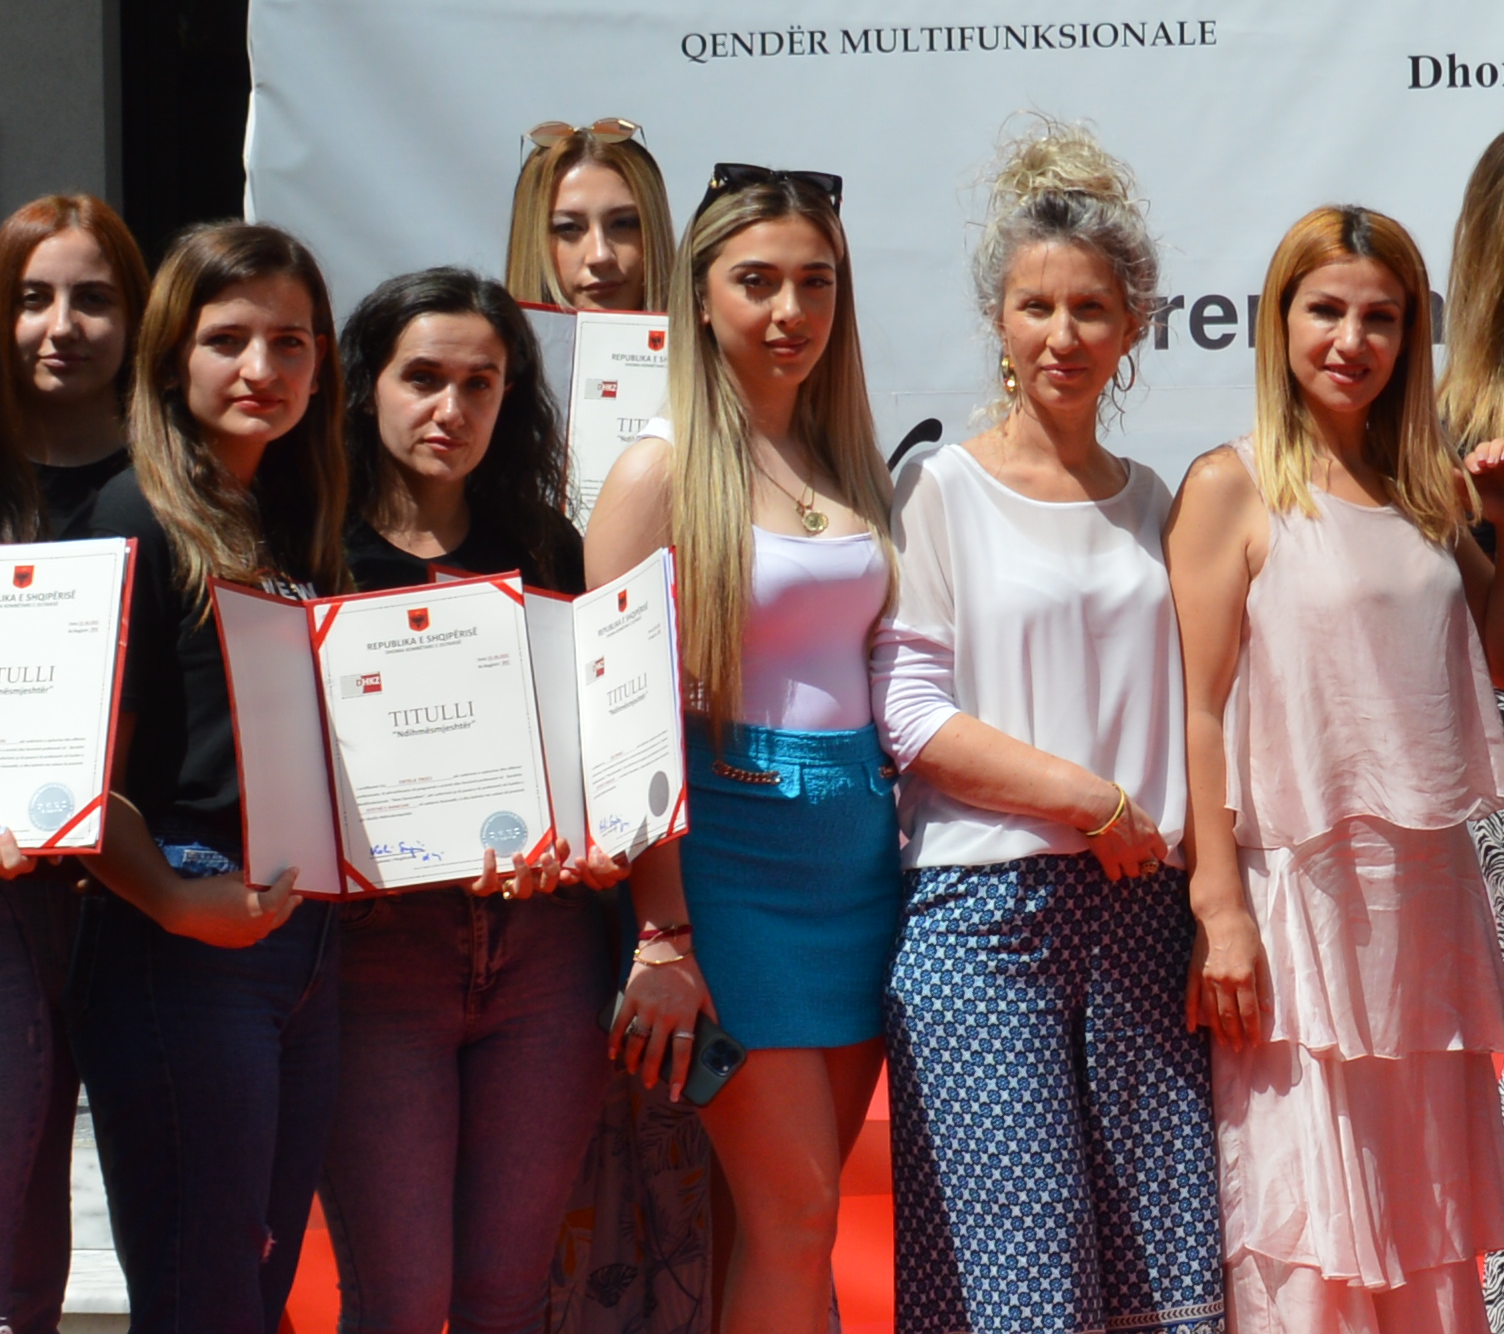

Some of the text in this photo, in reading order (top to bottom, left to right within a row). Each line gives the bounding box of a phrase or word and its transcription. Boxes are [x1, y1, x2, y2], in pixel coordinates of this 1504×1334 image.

[680, 20, 1218, 65] QENDËR MULTIFUNKSIONALE
[25, 589, 76, 603] SHQIPËRISË
[366, 637, 417, 651] REPUBLIKA
[426, 627, 478, 644] SHQIPËRISË
[606, 672, 648, 707] TITULLI
[388, 701, 475, 727] TITULLI
